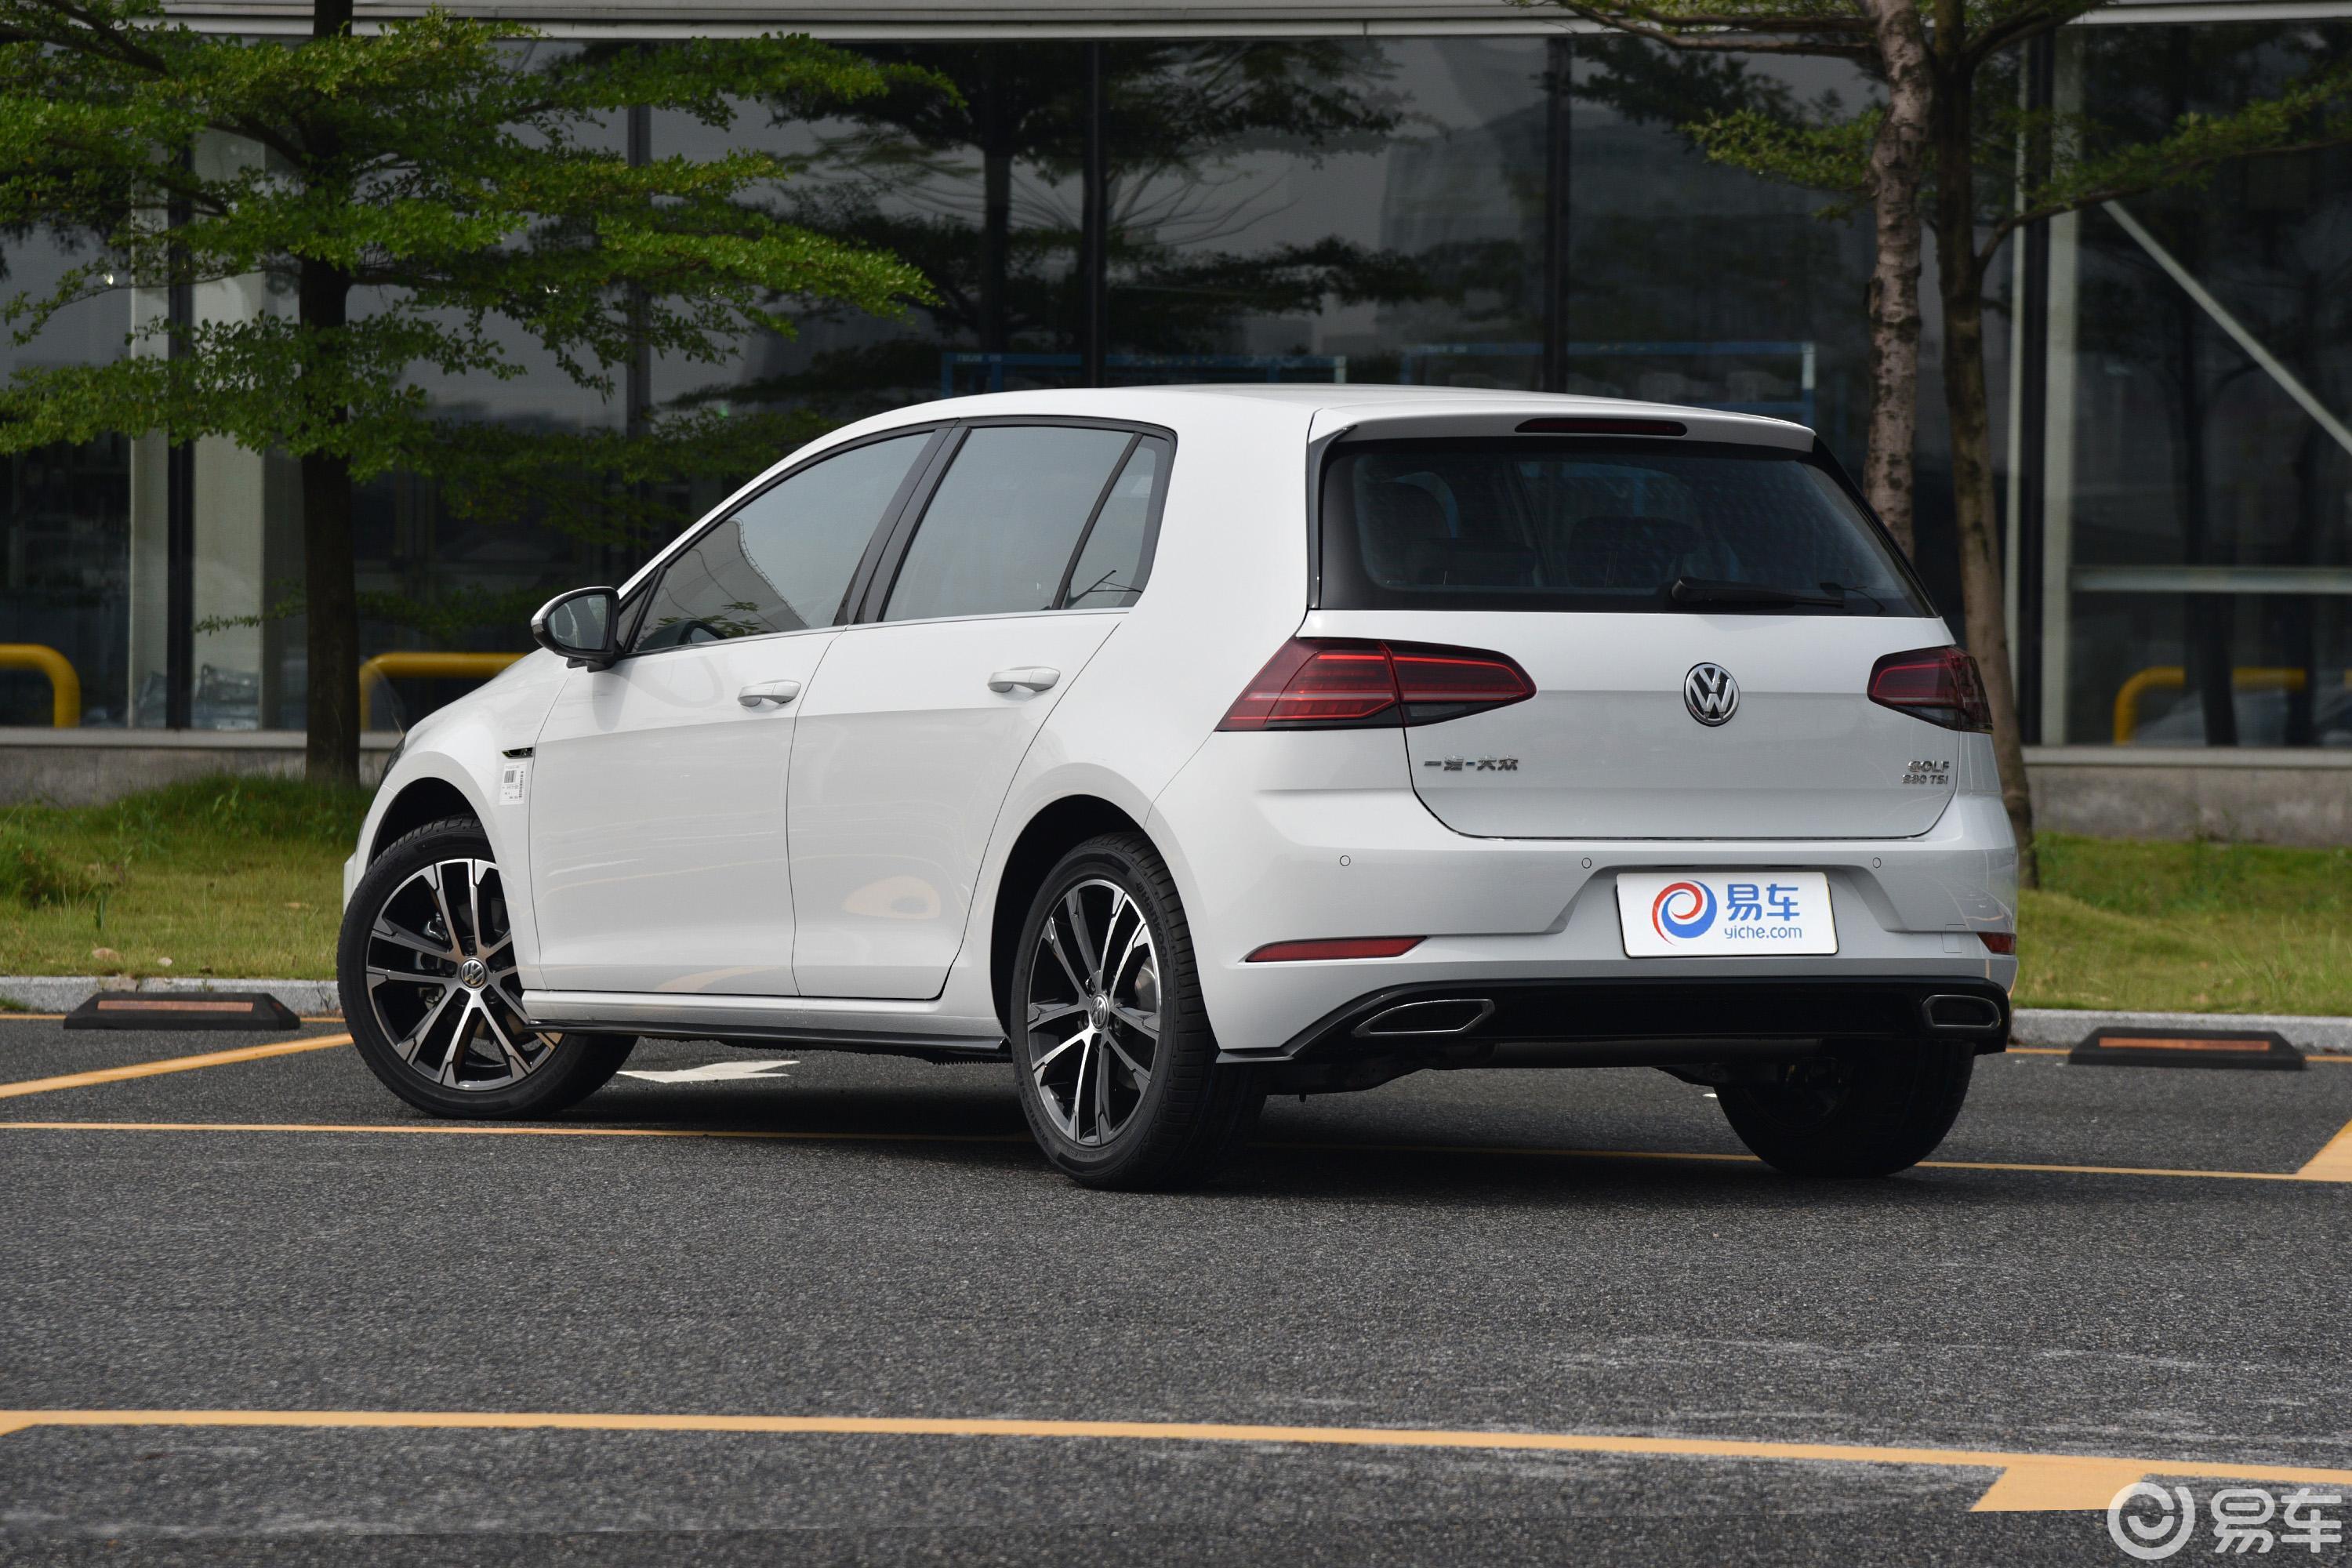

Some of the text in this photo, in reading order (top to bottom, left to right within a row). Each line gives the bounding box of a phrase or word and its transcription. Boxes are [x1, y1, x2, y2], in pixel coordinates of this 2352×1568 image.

[1683, 662, 1740, 727] VW
[1907, 760, 1950, 773] GOLF
[1929, 775, 1950, 785] TSI
[1726, 884, 1800, 921] 易车
[1724, 925, 1802, 939] yiche.com
